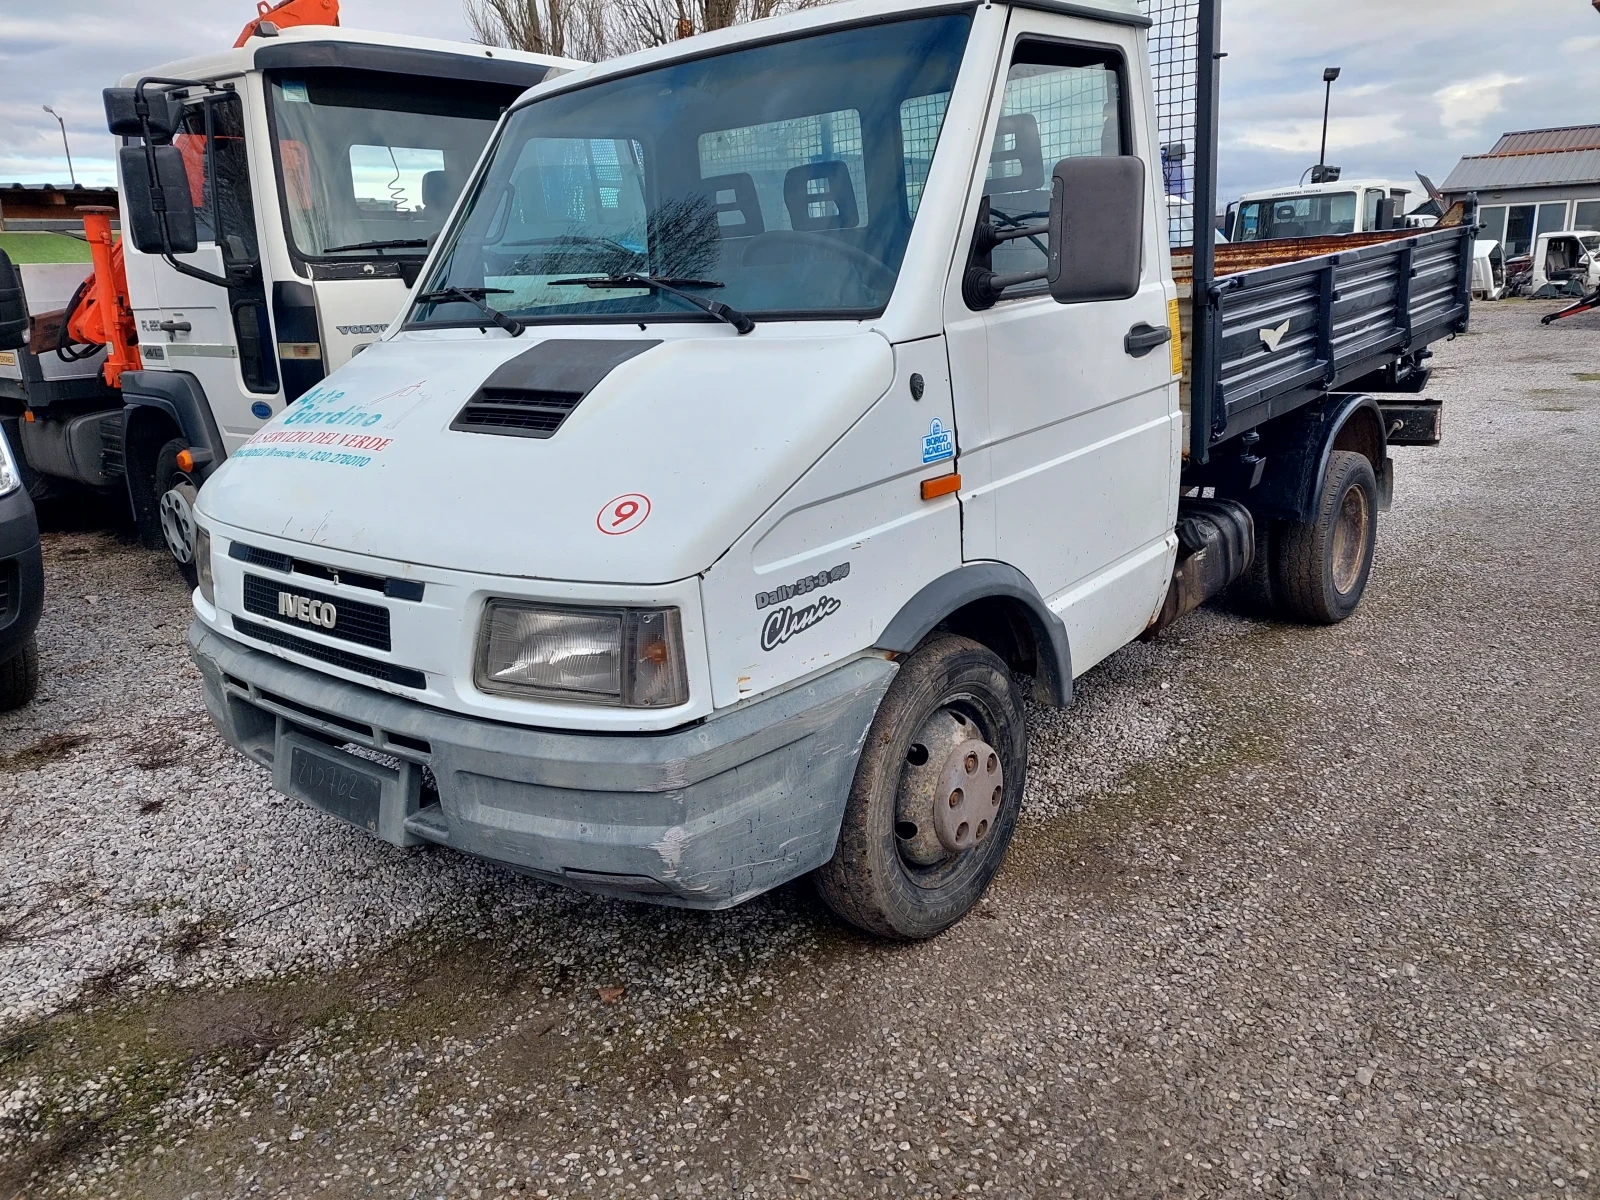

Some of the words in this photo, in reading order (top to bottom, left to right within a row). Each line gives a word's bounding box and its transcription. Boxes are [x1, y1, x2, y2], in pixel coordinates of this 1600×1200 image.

[295, 386, 345, 406] Arte
[284, 403, 382, 427] Giardino
[260, 431, 309, 445] SERVIZIO
[308, 432, 338, 446] DEL
[337, 434, 394, 451] VERDE
[924, 442, 952, 456] AGNELLO
[926, 434, 948, 447] BORGO
[309, 452, 331, 462] 030
[330, 454, 372, 467] 2780110
[612, 501, 639, 527] 9
[755, 584, 795, 610] Daily
[796, 570, 828, 595] 35-8
[278, 591, 336, 629] IVECO
[761, 595, 841, 652] Classic
